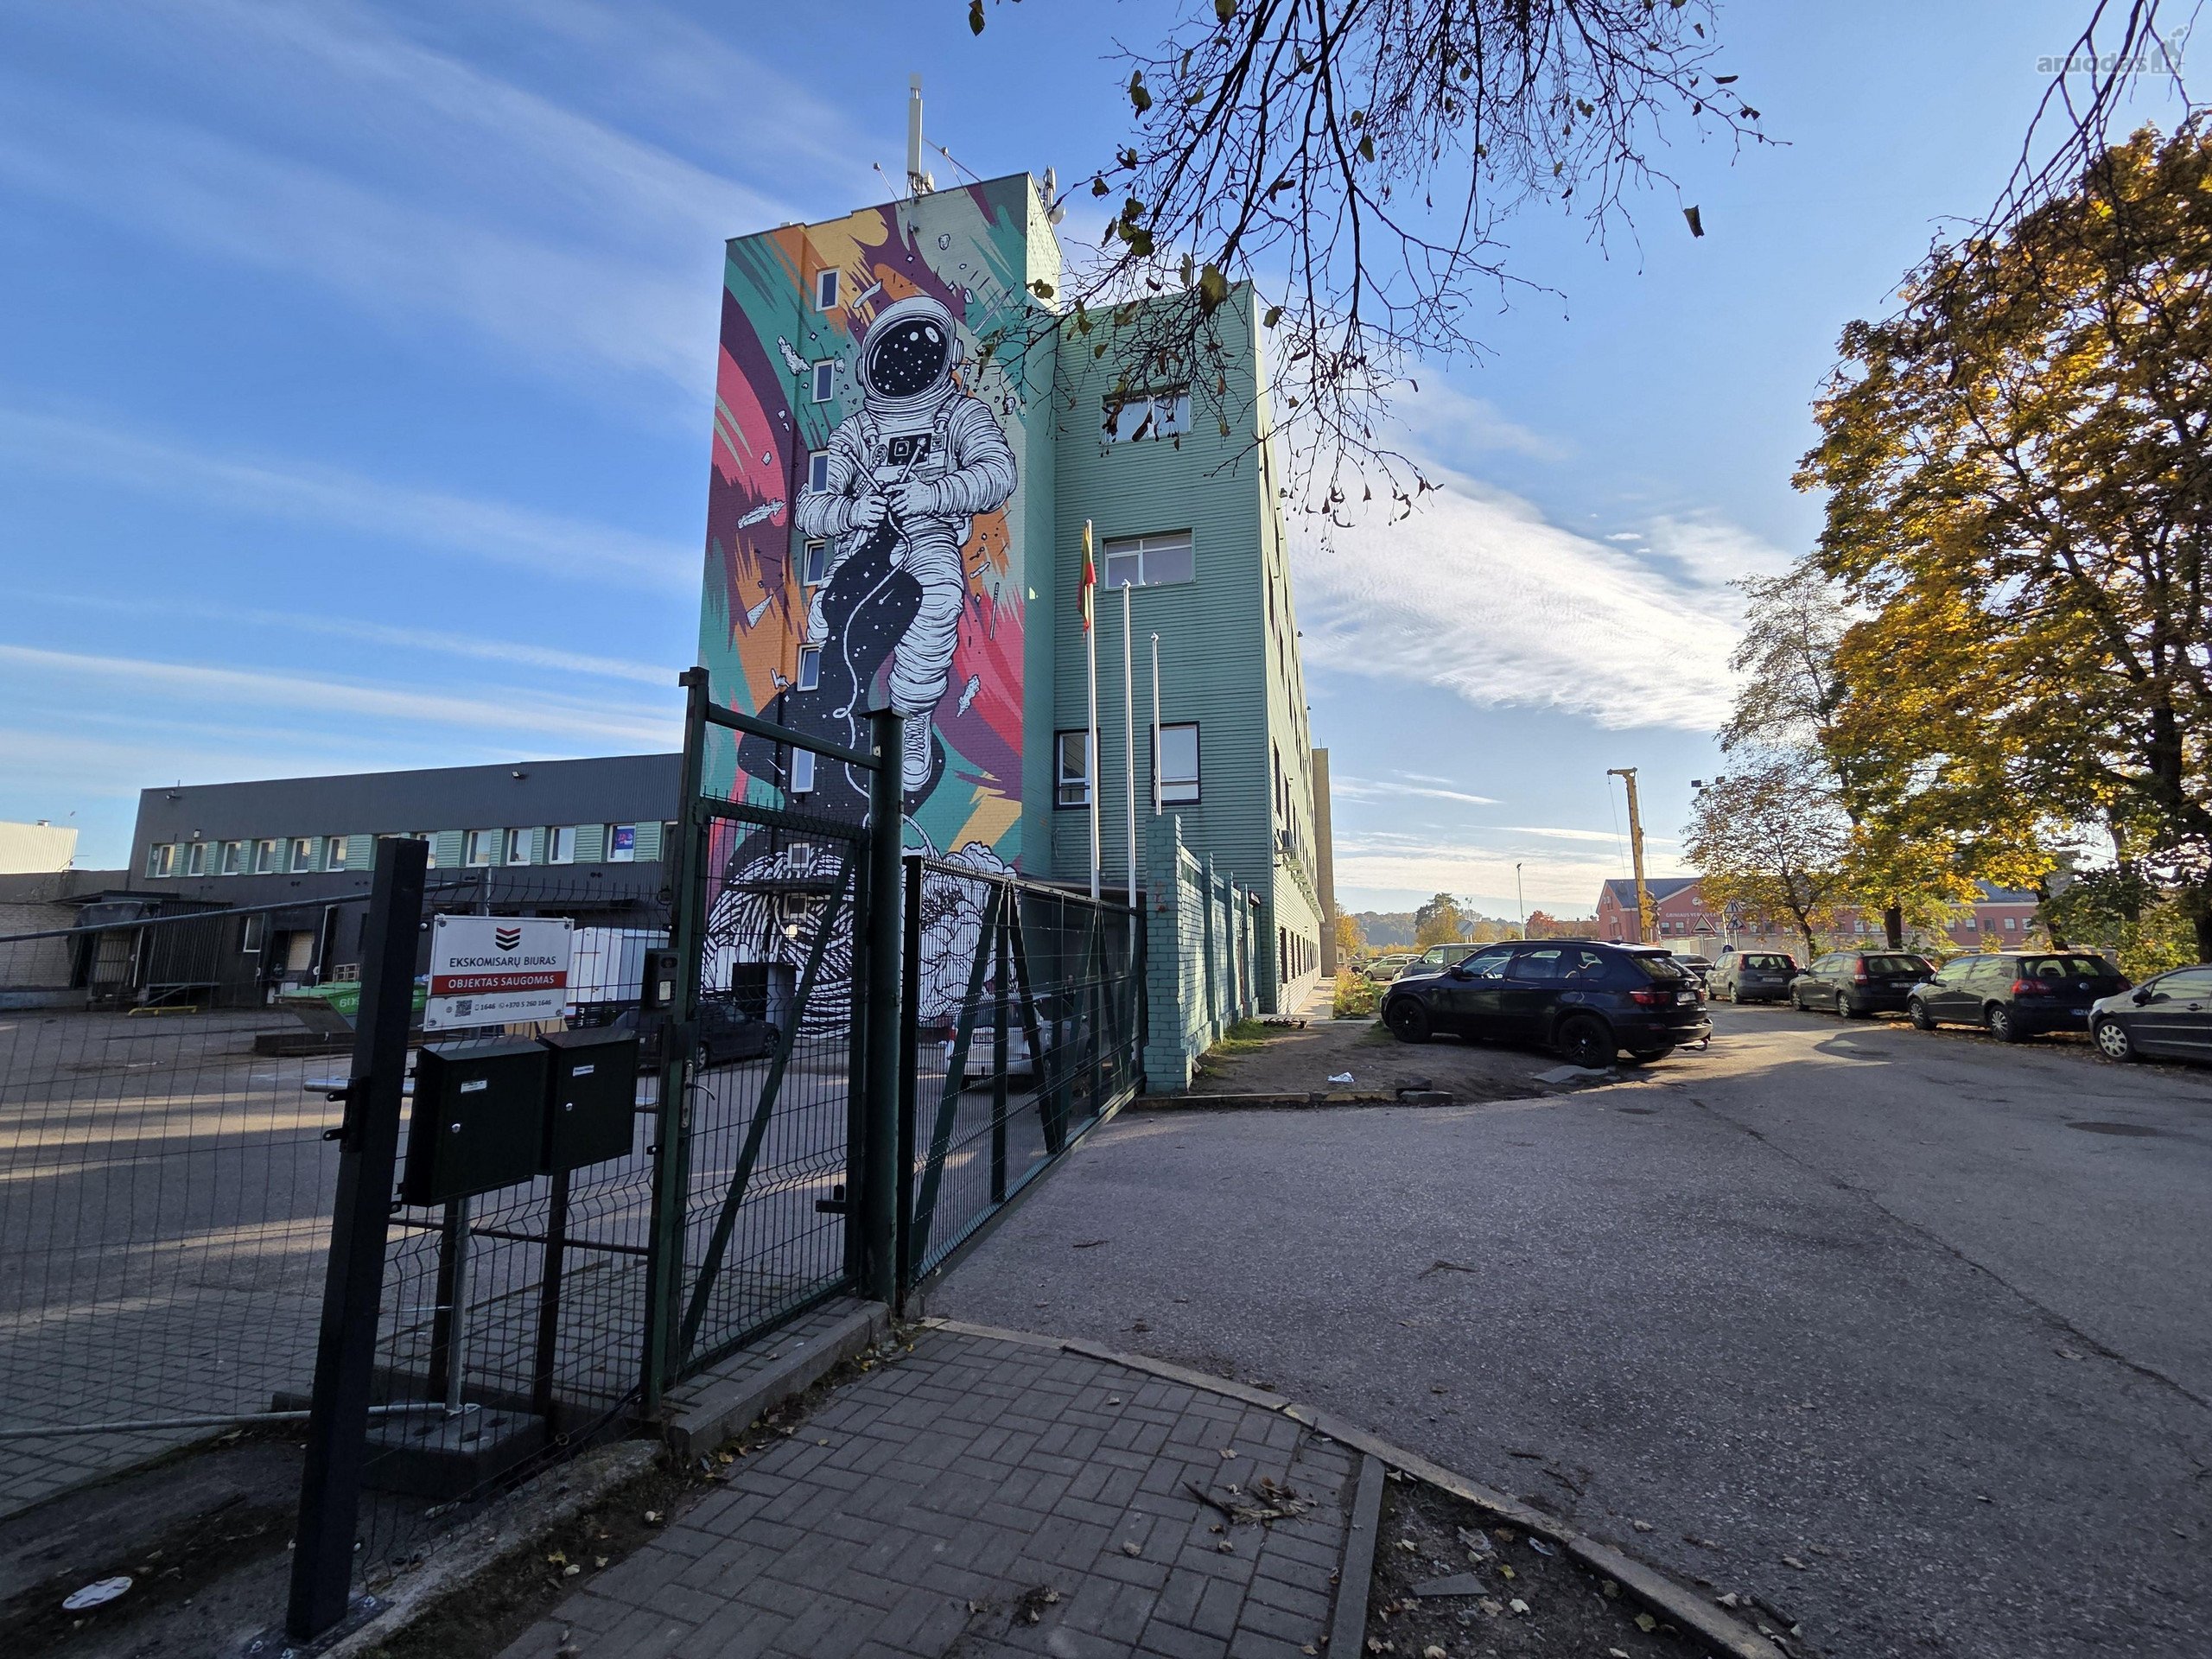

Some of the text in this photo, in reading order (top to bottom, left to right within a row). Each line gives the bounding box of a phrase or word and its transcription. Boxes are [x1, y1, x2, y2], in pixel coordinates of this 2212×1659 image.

[449, 956, 556, 968] EKSKOMISARŲ BIURAS
[448, 975, 555, 988] OBJEKTAS SAUGOMAS
